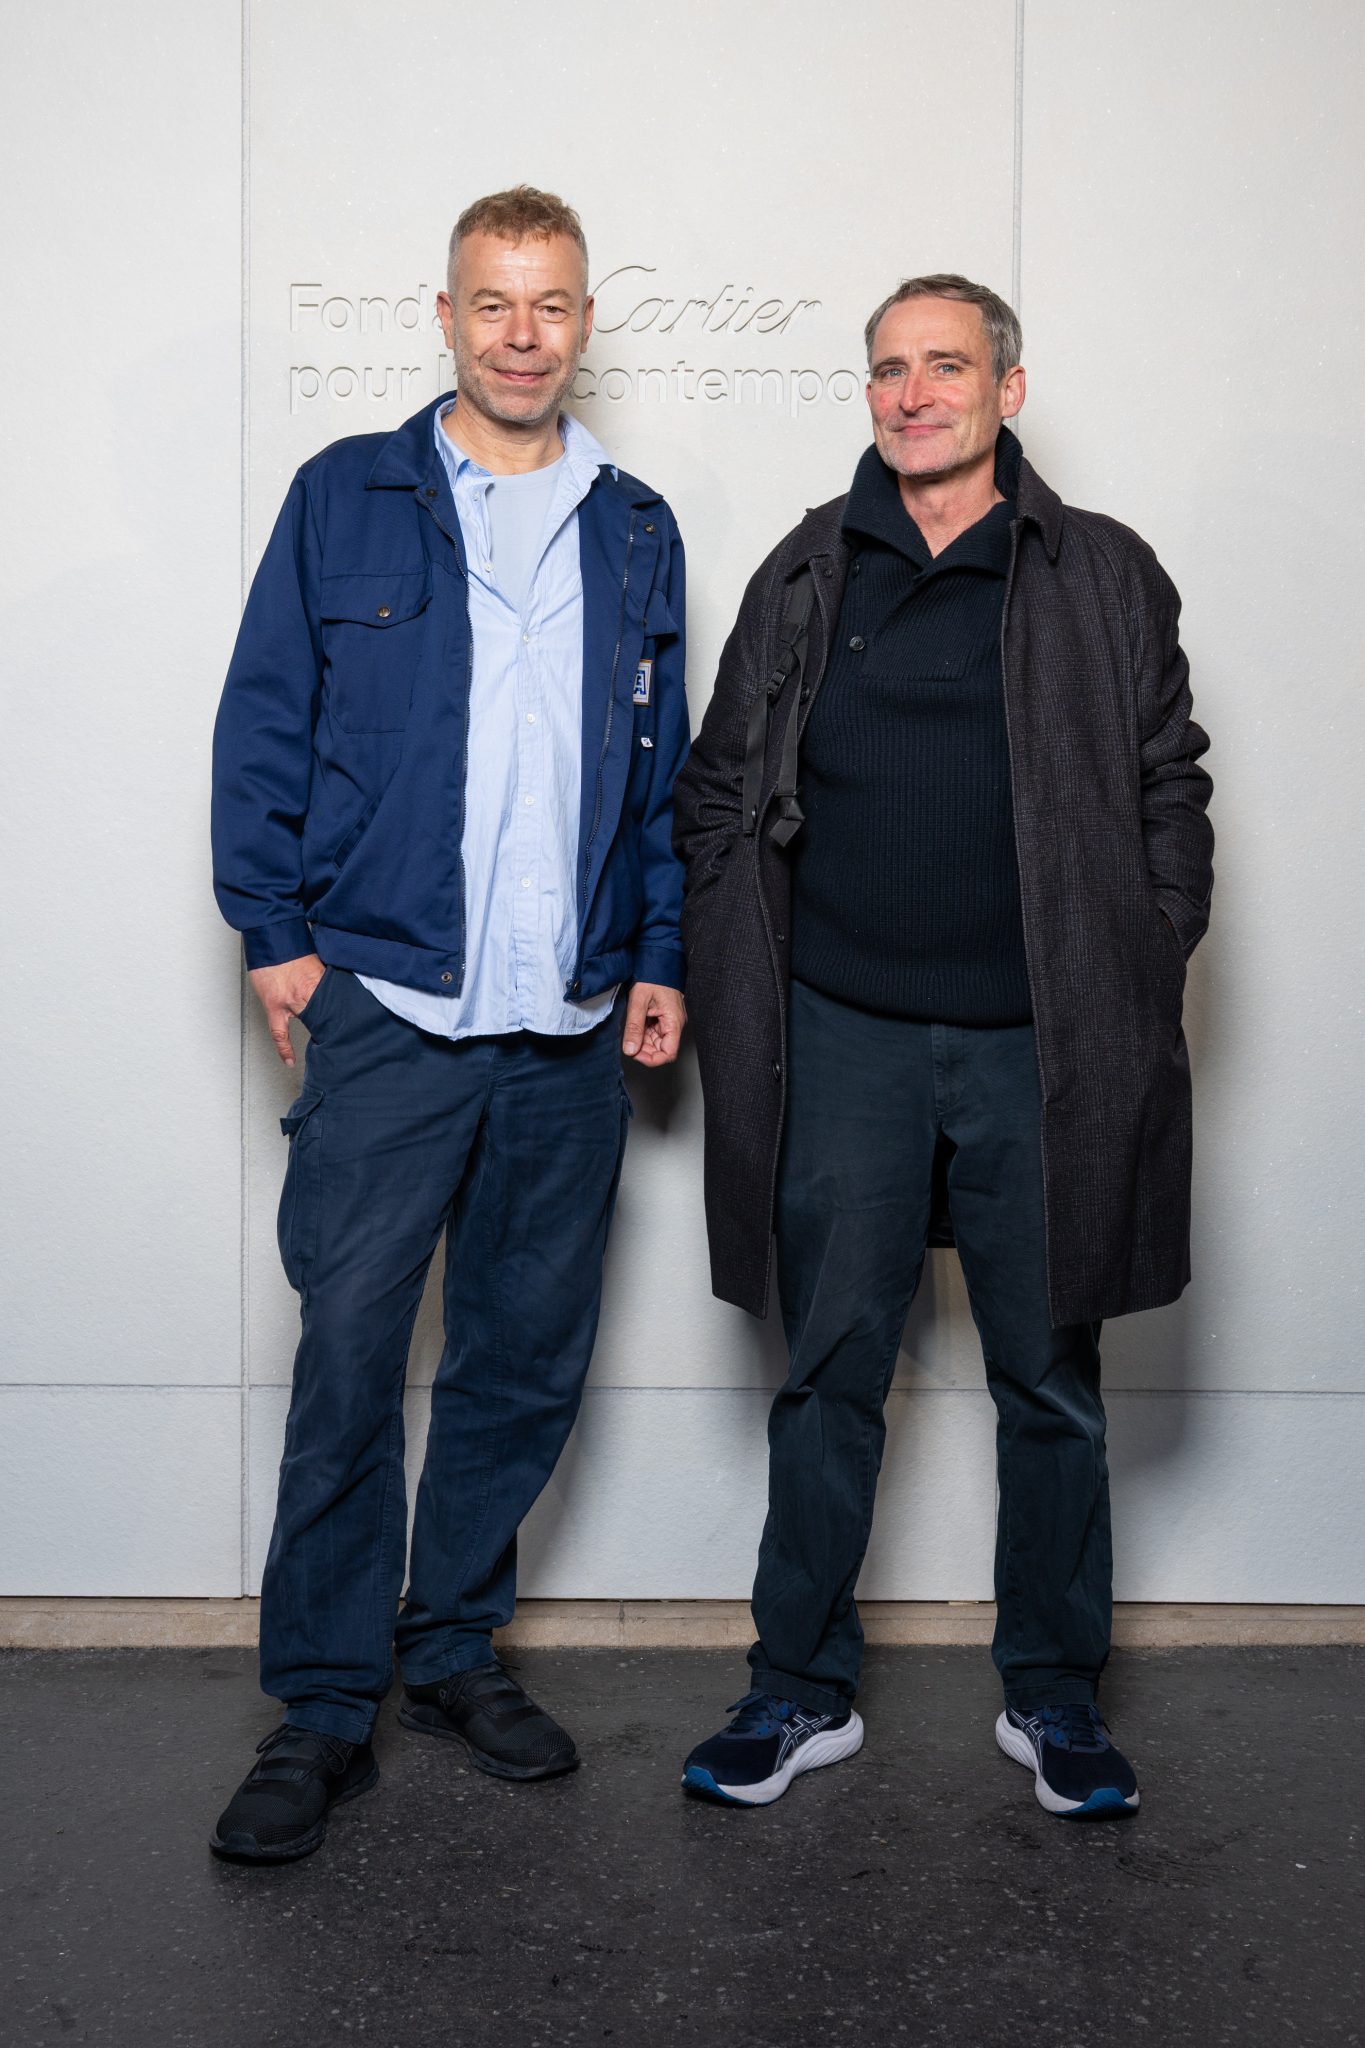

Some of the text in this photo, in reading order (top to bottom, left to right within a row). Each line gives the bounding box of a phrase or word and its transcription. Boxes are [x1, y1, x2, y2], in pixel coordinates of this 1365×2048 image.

[588, 265, 823, 336] Cartier
[289, 365, 422, 416] pour
[571, 360, 870, 418] contempo
